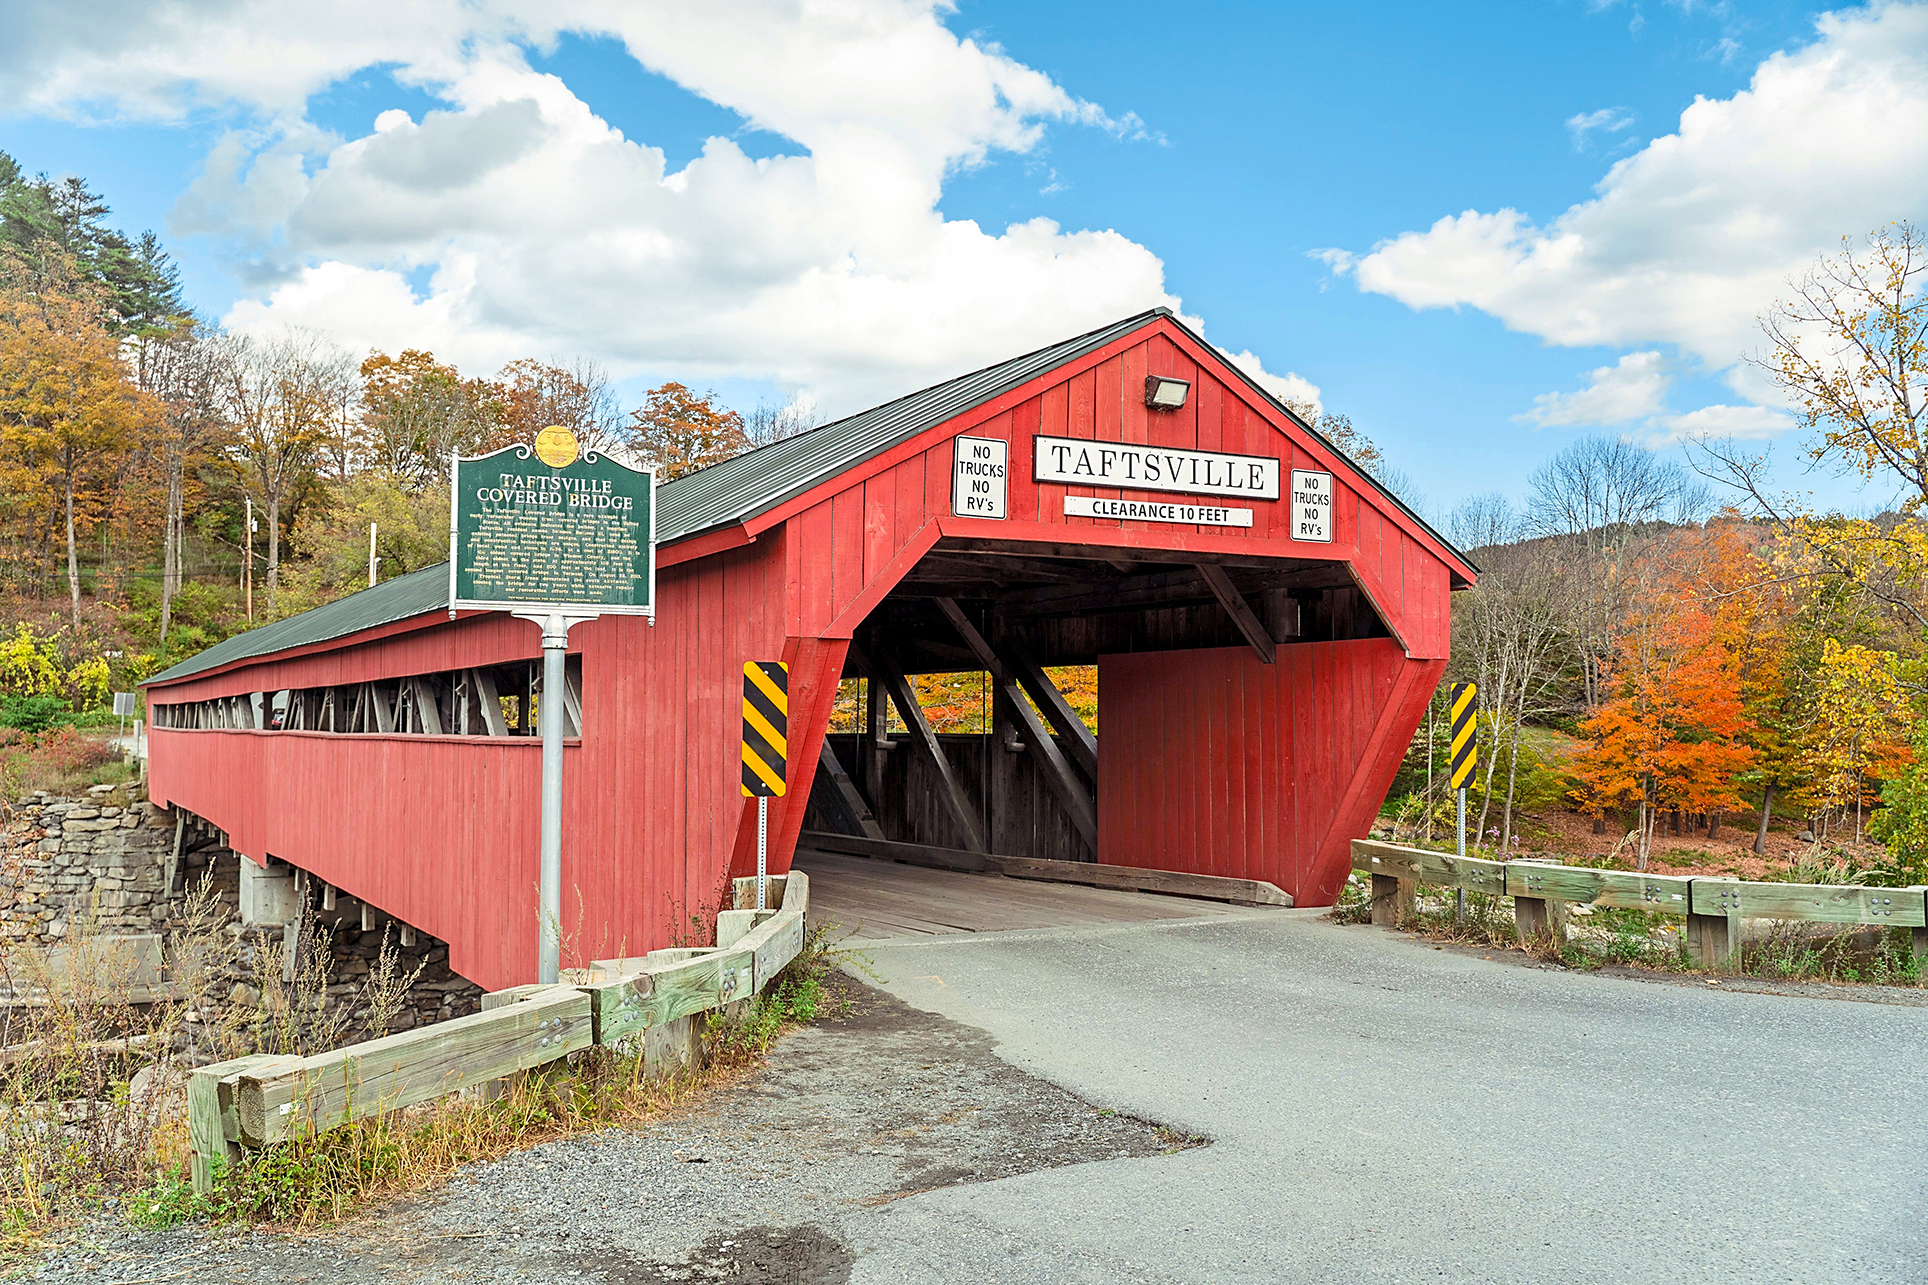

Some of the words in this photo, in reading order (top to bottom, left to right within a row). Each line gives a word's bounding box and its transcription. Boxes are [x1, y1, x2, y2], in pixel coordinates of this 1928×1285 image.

[973, 445, 991, 459] NO
[959, 461, 1004, 478] TRUCKS
[1051, 445, 1265, 490] TAFTSVILLE
[500, 473, 612, 493] TAFTSVILLE
[972, 480, 990, 494] NO
[1304, 477, 1319, 490] NO
[476, 488, 562, 506] COVERED
[569, 493, 633, 510] BRIDGE
[967, 496, 994, 512] RV's
[1294, 491, 1330, 506] TRUCKS
[1092, 501, 1175, 519] CLEARANCE
[1179, 507, 1195, 520] 10
[1199, 508, 1229, 522] FEET
[1304, 507, 1319, 520] NO
[1300, 522, 1322, 536] RV's
